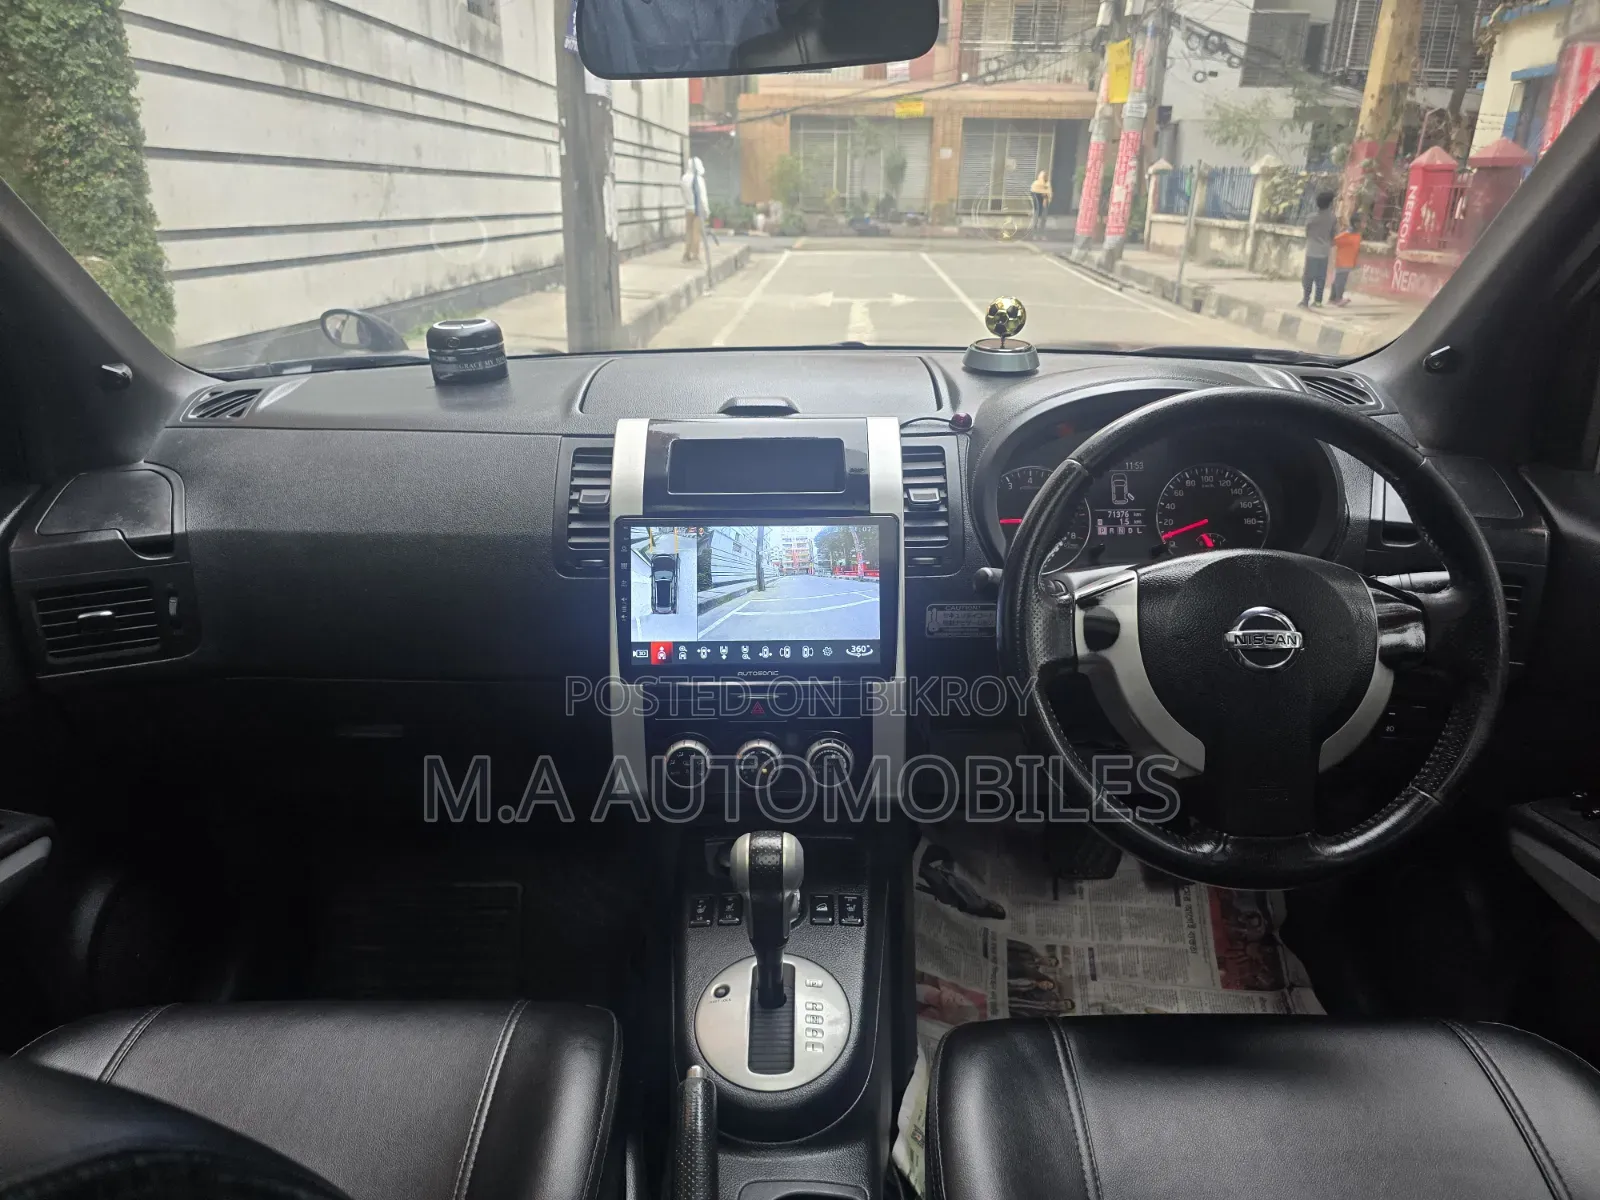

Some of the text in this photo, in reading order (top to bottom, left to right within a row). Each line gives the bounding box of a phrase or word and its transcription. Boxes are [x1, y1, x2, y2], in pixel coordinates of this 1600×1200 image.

[1125, 461, 1144, 470] 11:53
[1186, 479, 1196, 487] 80
[1174, 489, 1184, 497] 60
[1231, 488, 1243, 496] 140
[1107, 510, 1130, 518] 71376
[1163, 518, 1174, 526] 20
[1234, 635, 1297, 645] NISSAN
[812, 1002, 818, 1010] R
[812, 1029, 818, 1037] D
[812, 1043, 818, 1051] L
